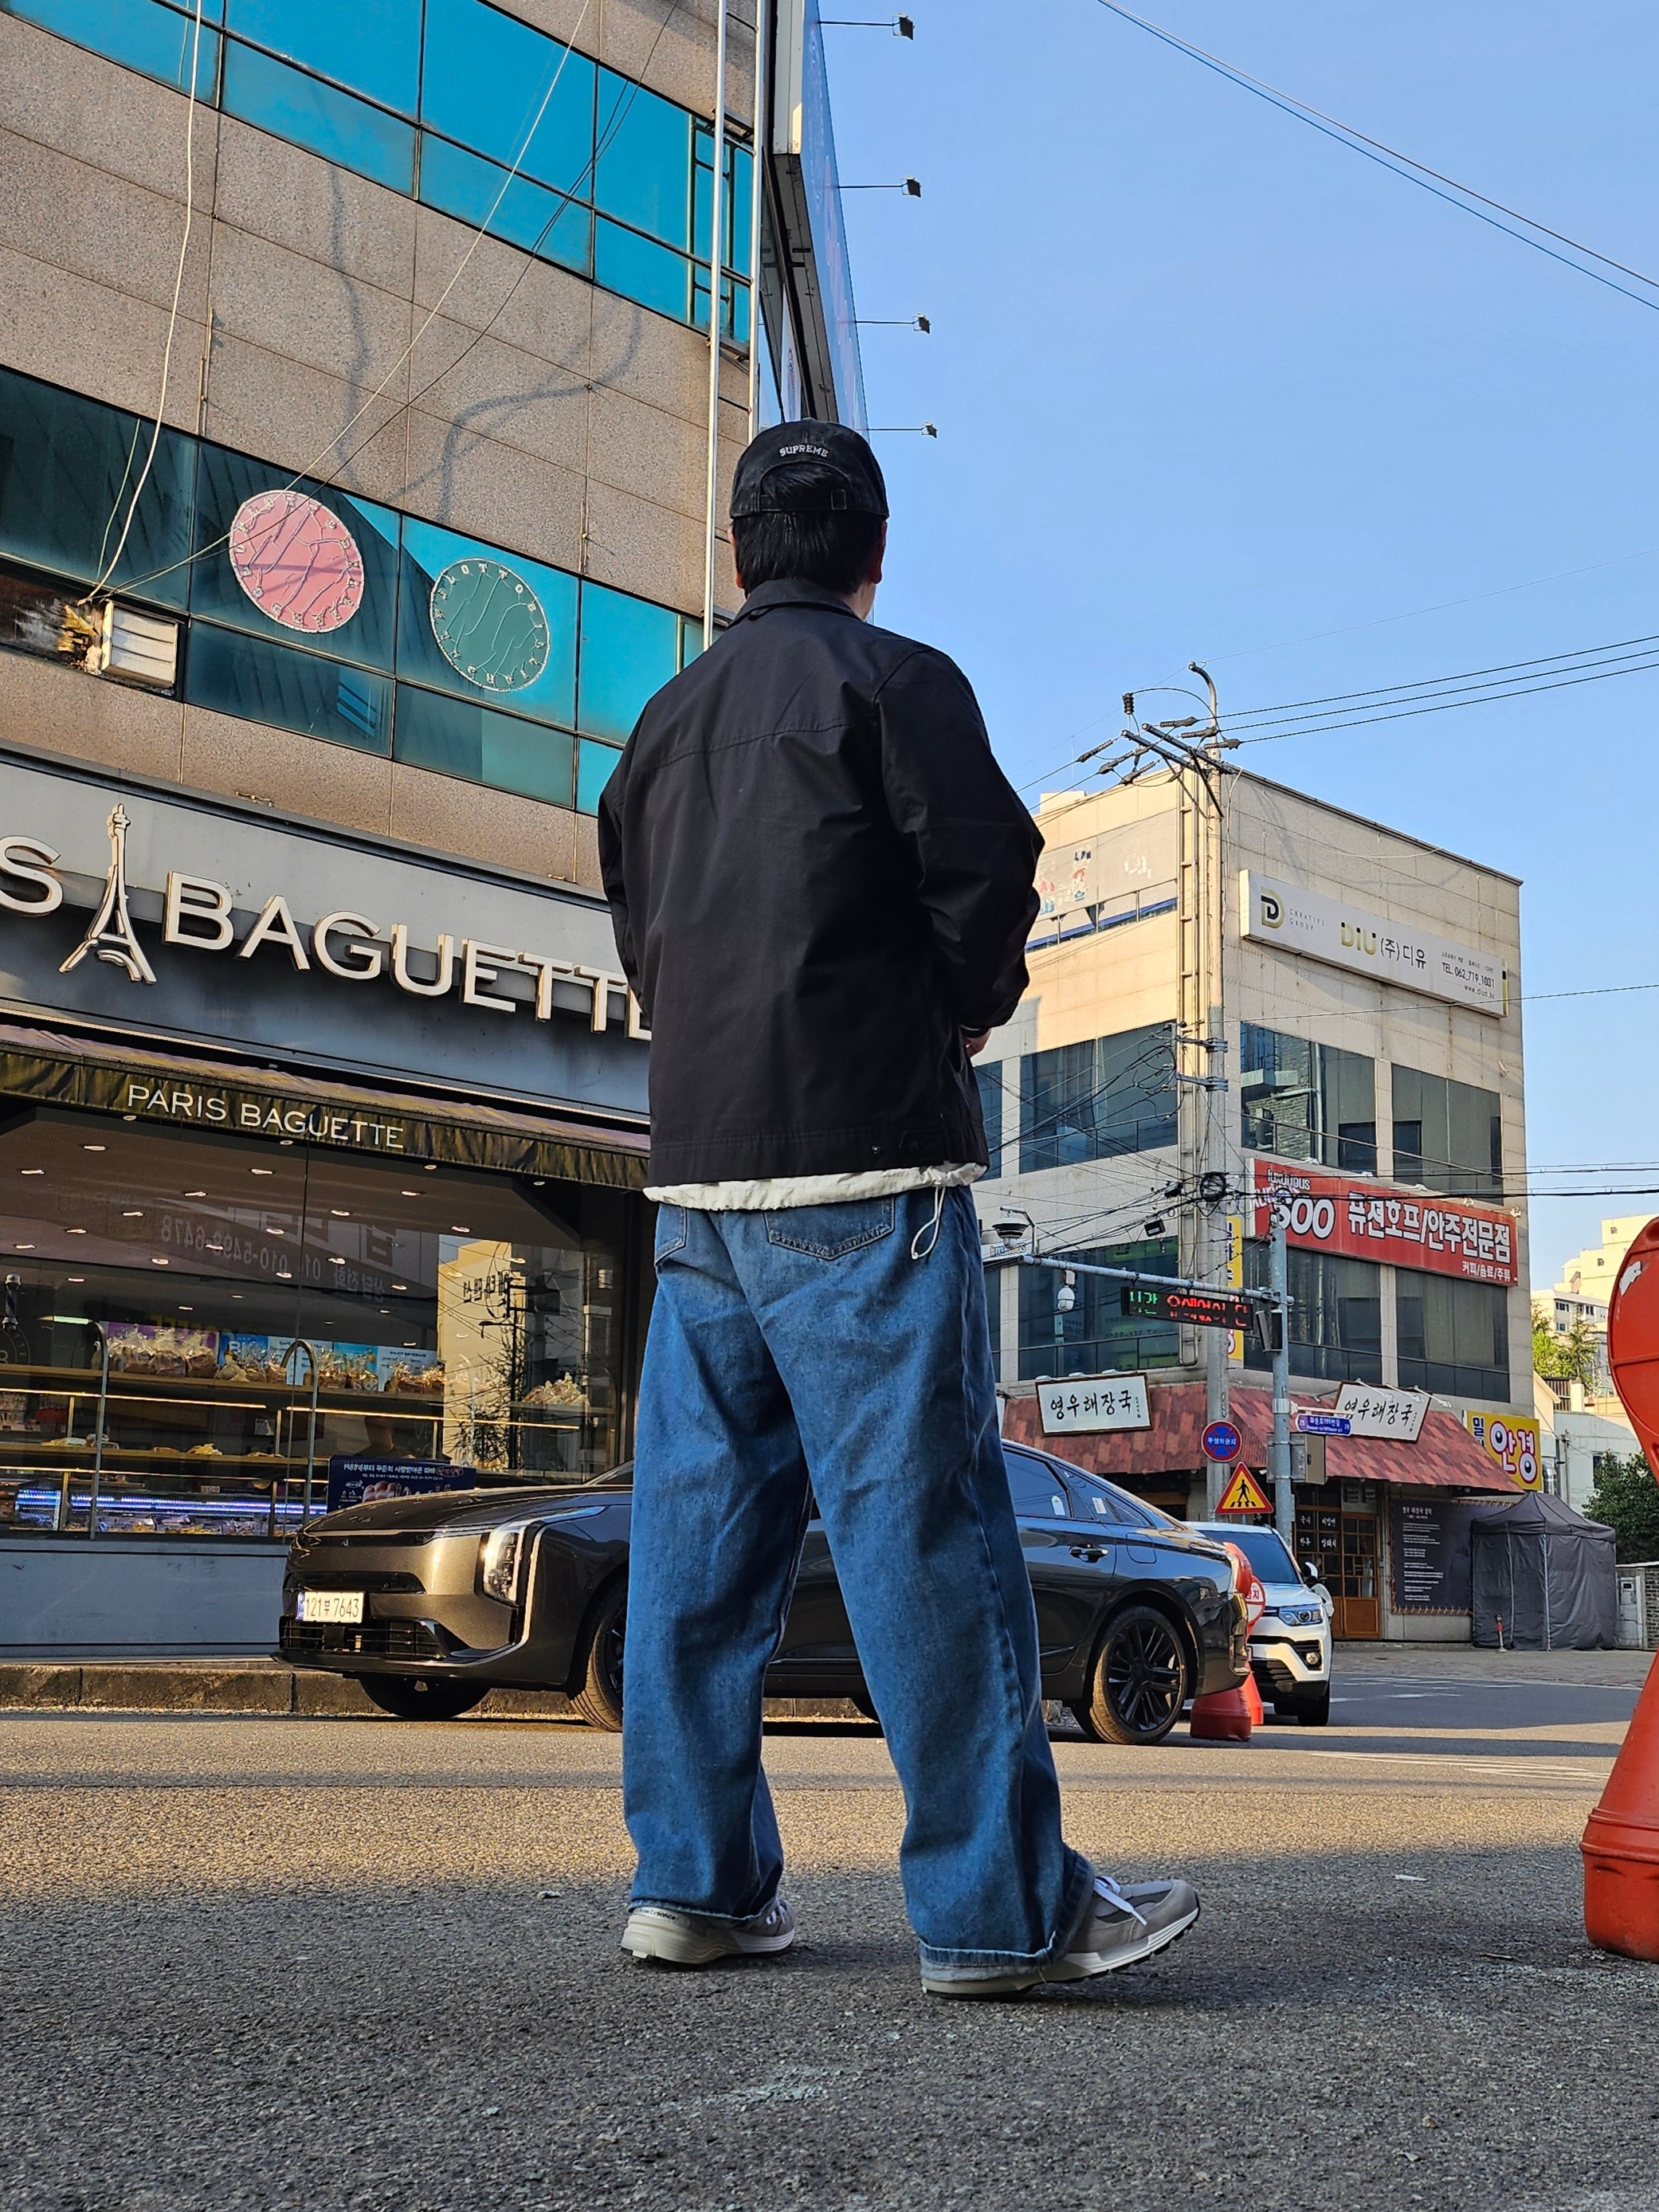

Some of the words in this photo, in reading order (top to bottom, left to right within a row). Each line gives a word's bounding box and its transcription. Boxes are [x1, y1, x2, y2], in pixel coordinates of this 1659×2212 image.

[779, 444, 829, 458] SUPREME
[1288, 918, 1315, 931] GROUP
[1441, 962, 1453, 975] TEL
[128, 1084, 226, 1121] PARIS
[241, 1104, 404, 1149] BAGUETTE
[1348, 1192, 1512, 1264] 퓨전호프/안주전문점
[1461, 1261, 1511, 1282] 커피/음료/주류
[1050, 1390, 1131, 1420] 영우해장국
[1207, 1437, 1236, 1445] 주정차금지
[1489, 1421, 1538, 1484] 안경
[306, 1598, 330, 1616] 121부
[334, 1598, 359, 1617] 7643
